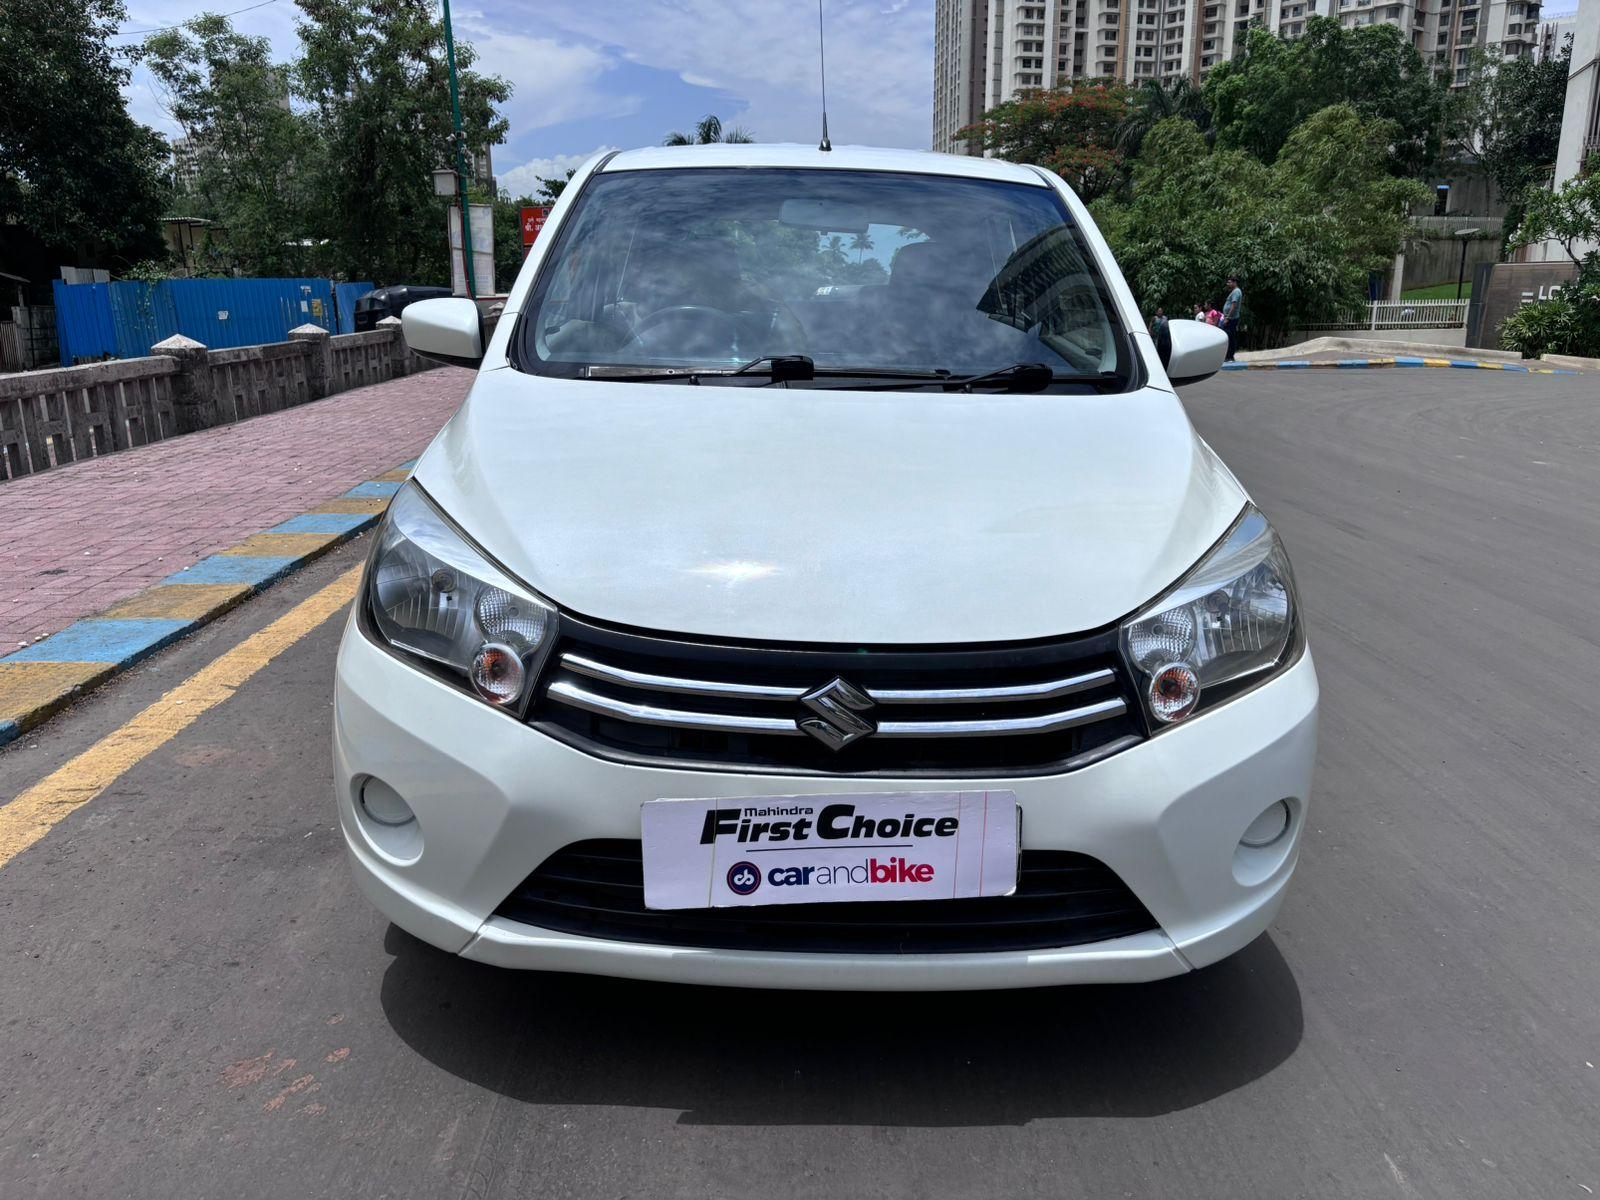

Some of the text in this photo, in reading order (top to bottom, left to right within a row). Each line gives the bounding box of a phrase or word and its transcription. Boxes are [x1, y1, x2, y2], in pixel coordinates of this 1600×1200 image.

[699, 804, 959, 844] First Choice
[744, 806, 814, 817] Mahindra
